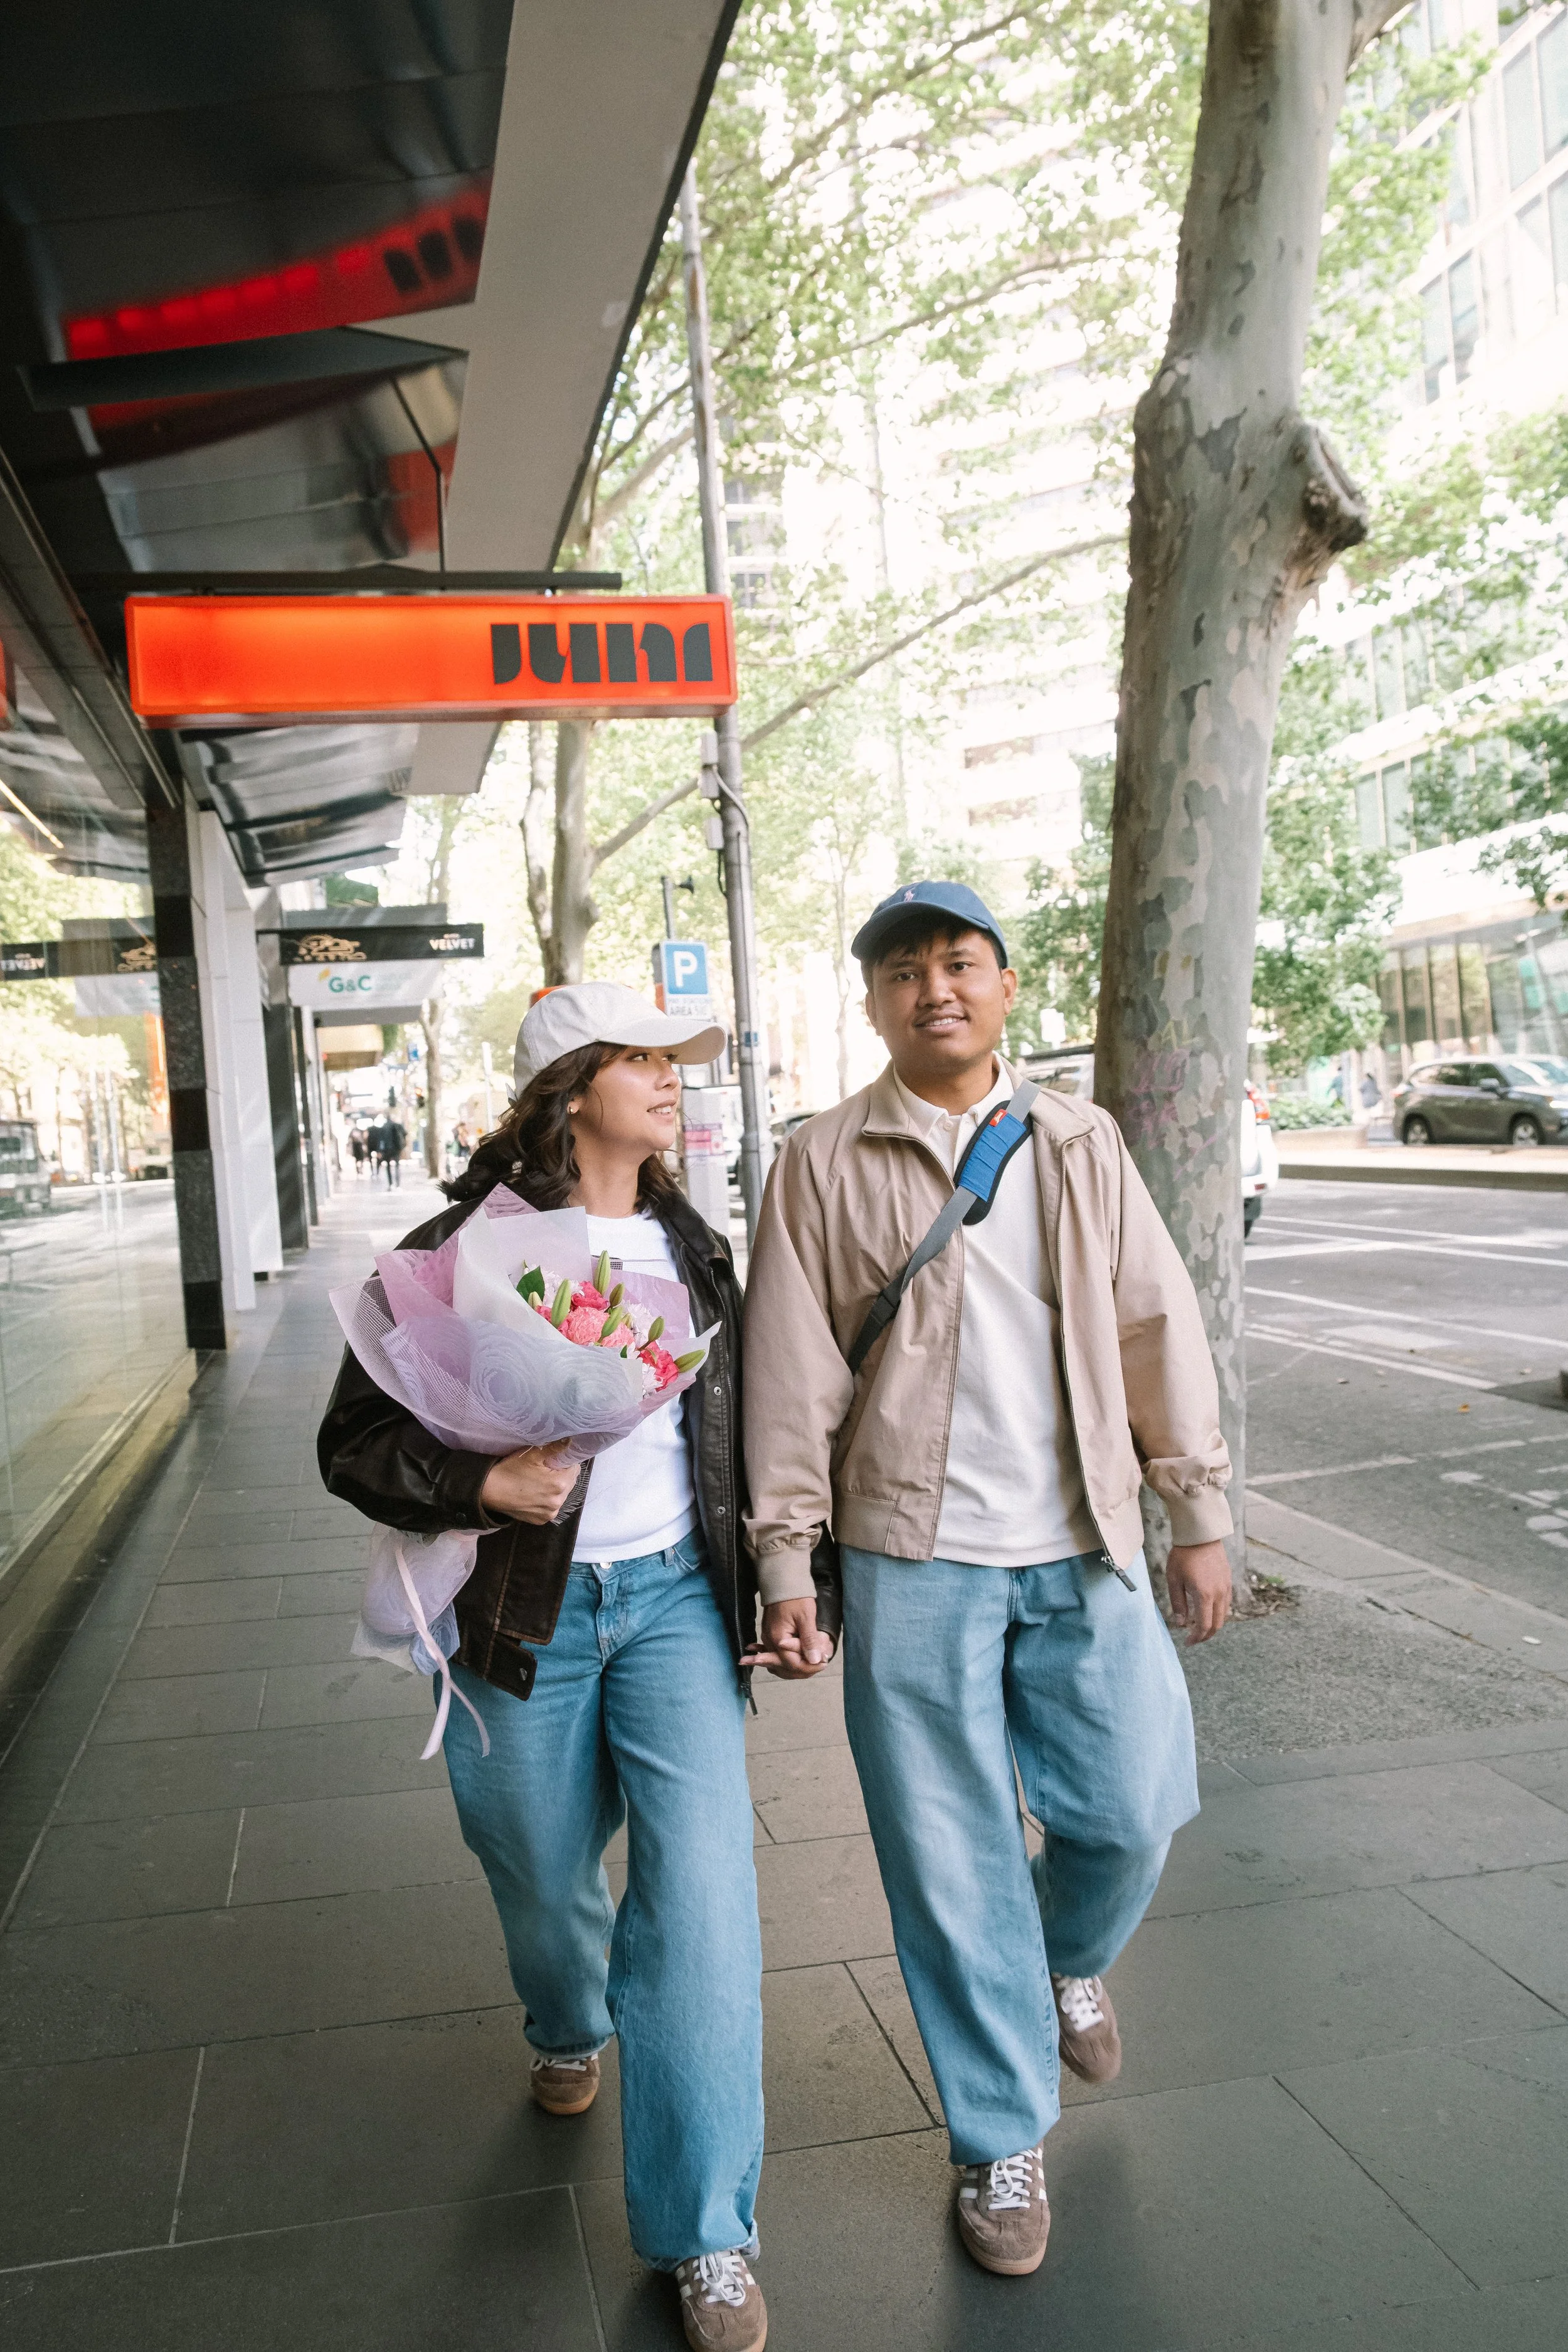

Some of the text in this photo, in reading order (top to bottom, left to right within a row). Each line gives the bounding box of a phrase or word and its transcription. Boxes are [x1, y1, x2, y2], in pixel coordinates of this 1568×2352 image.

[429, 938, 475, 950] VELVET
[674, 951, 697, 988] P
[328, 975, 372, 993] G&C
